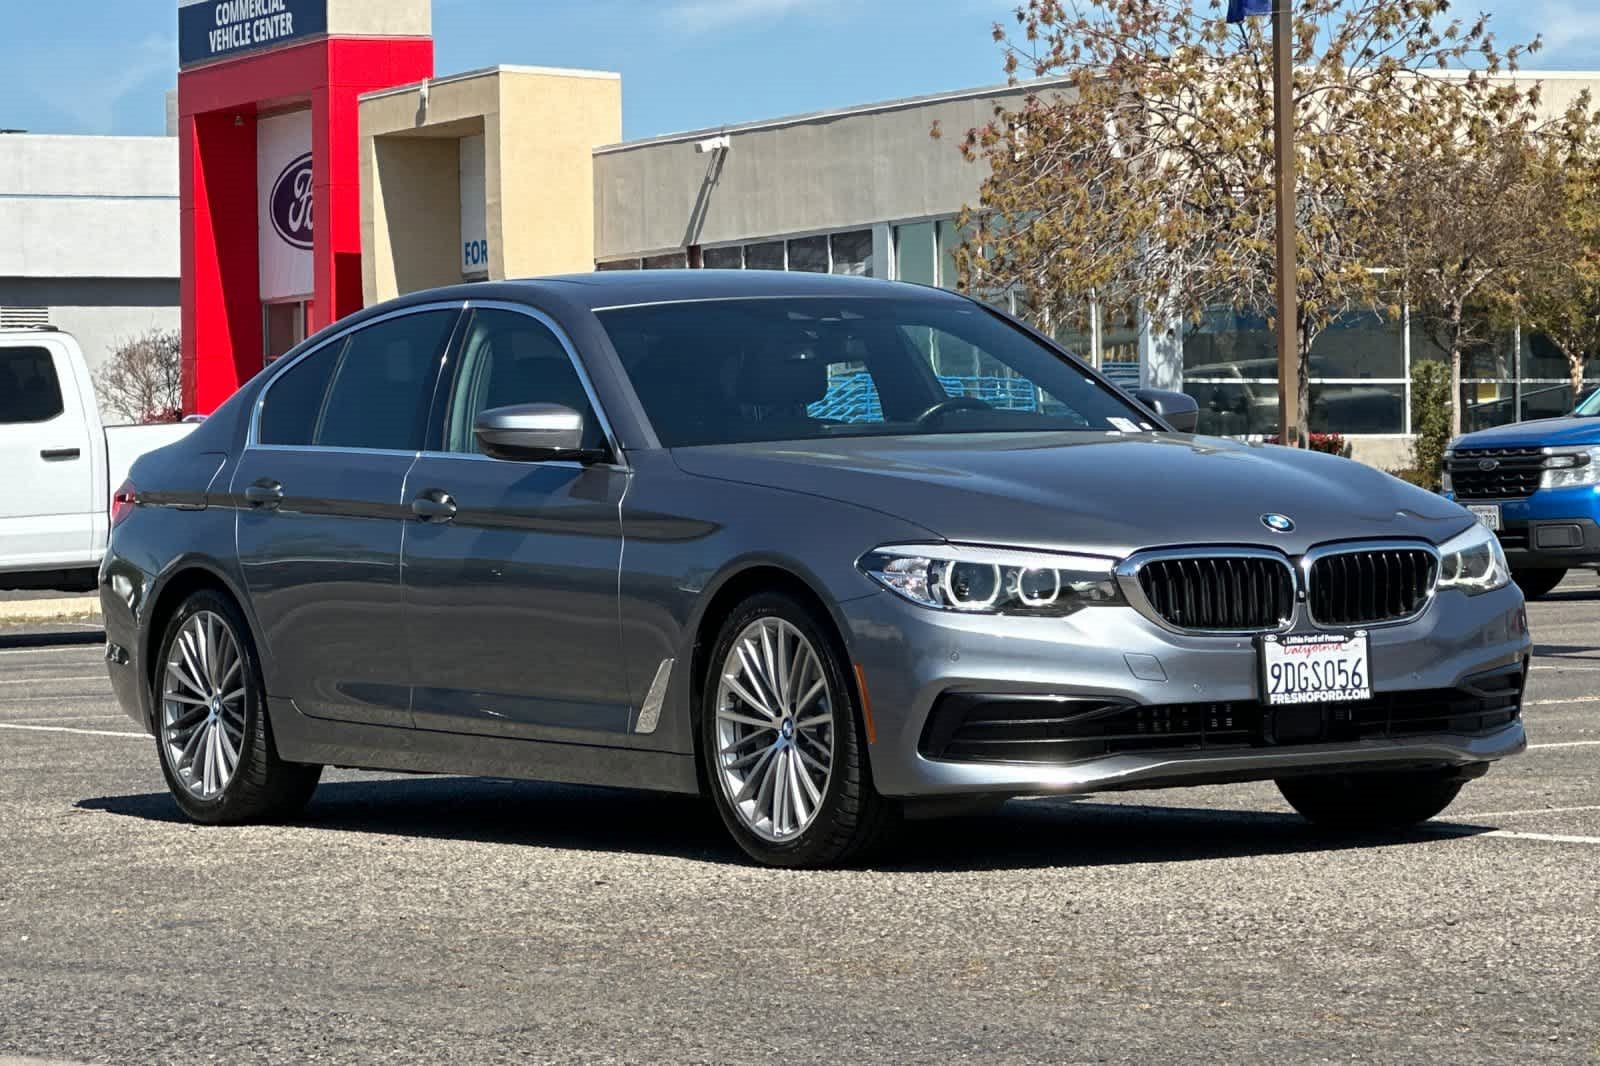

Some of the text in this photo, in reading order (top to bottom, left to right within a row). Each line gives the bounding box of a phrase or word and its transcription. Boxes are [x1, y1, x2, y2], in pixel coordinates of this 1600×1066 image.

[215, 0, 286, 26] COMMERCIAL
[208, 12, 294, 53] VEHICLE CENTER
[464, 239, 488, 266] FOR
[1304, 634, 1317, 644] Ford
[1318, 634, 1324, 643] of
[1325, 633, 1345, 642] Fresno
[1271, 658, 1362, 694] 9DGS056
[1270, 688, 1370, 705] FRESNOFORD.COM
